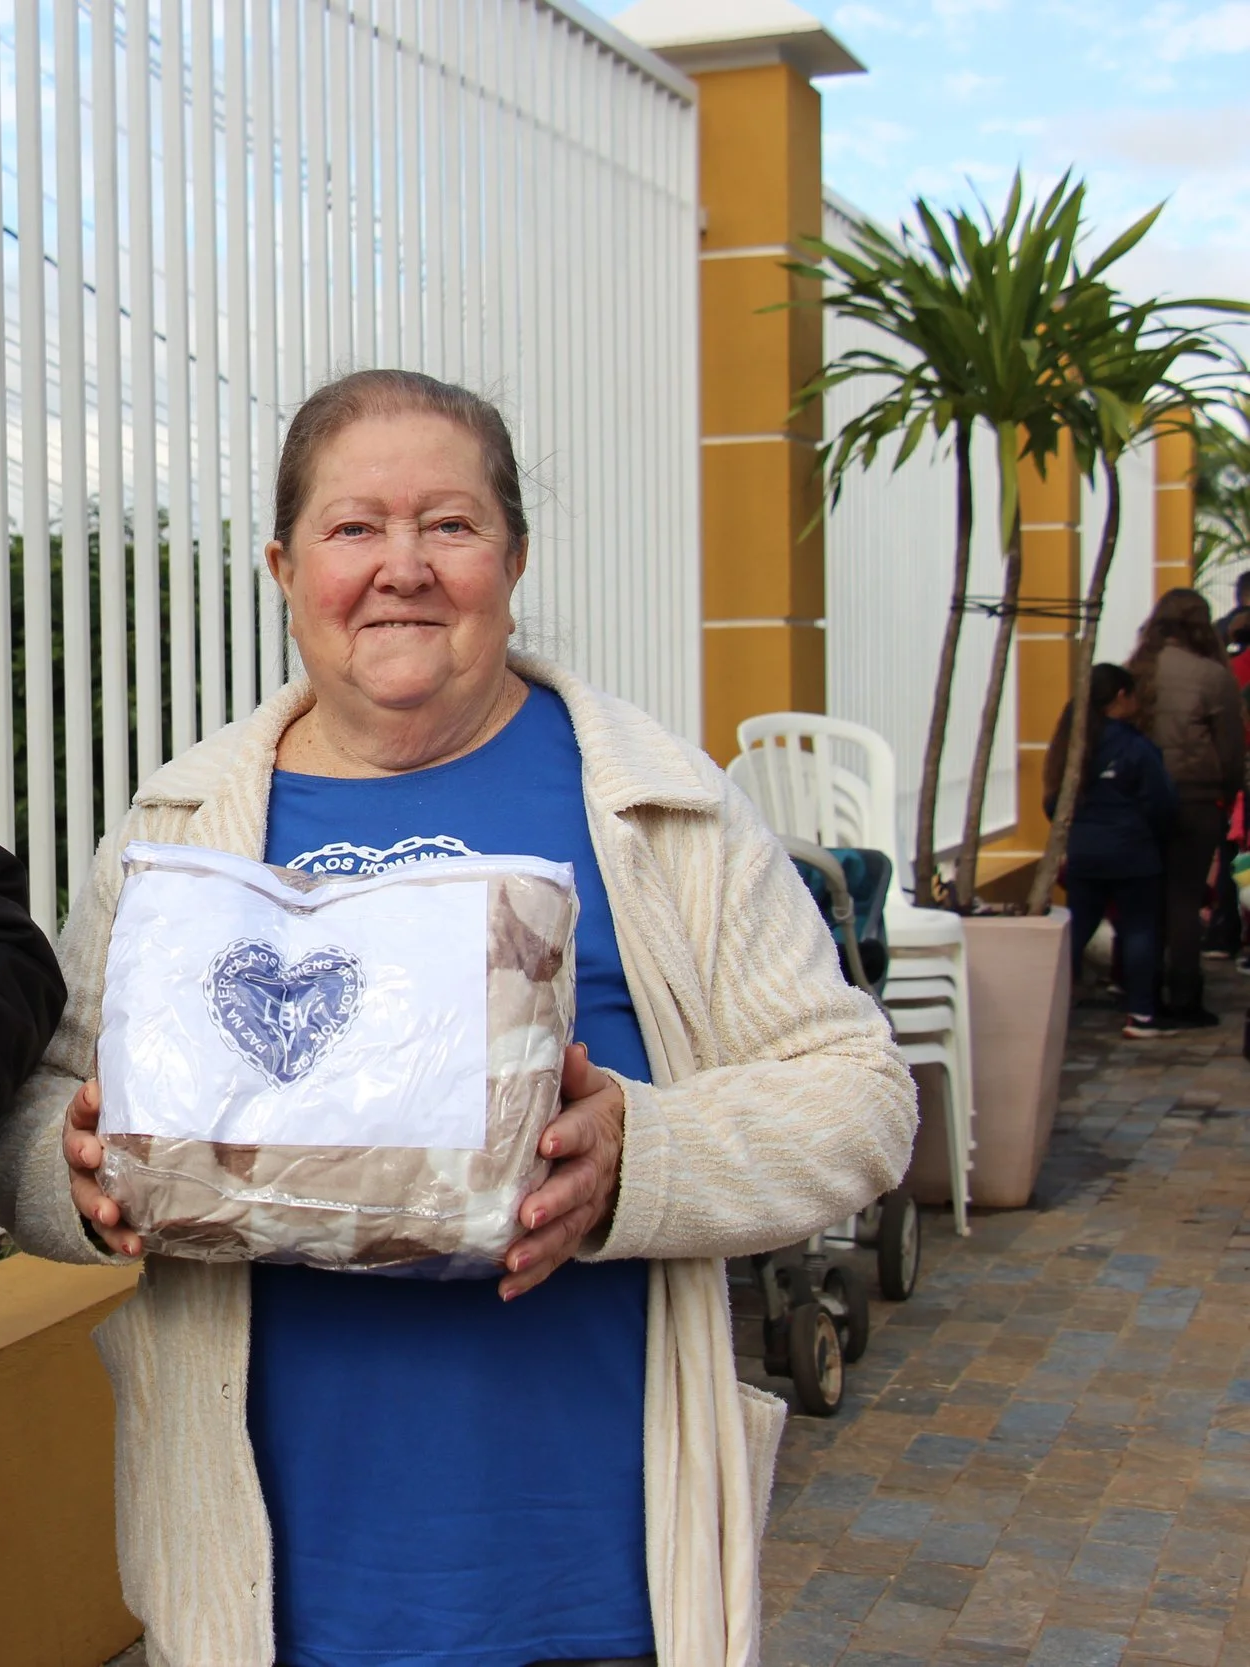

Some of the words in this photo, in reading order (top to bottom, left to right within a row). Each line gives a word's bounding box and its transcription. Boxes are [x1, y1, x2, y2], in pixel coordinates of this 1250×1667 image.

[312, 857, 354, 874] AOS
[248, 951, 278, 968] AOS
[218, 958, 246, 1008] TERRA
[336, 984, 356, 1015] BOA
[226, 1008, 245, 1029] NA
[264, 999, 312, 1031] LBV
[241, 1027, 268, 1053] PAZ
